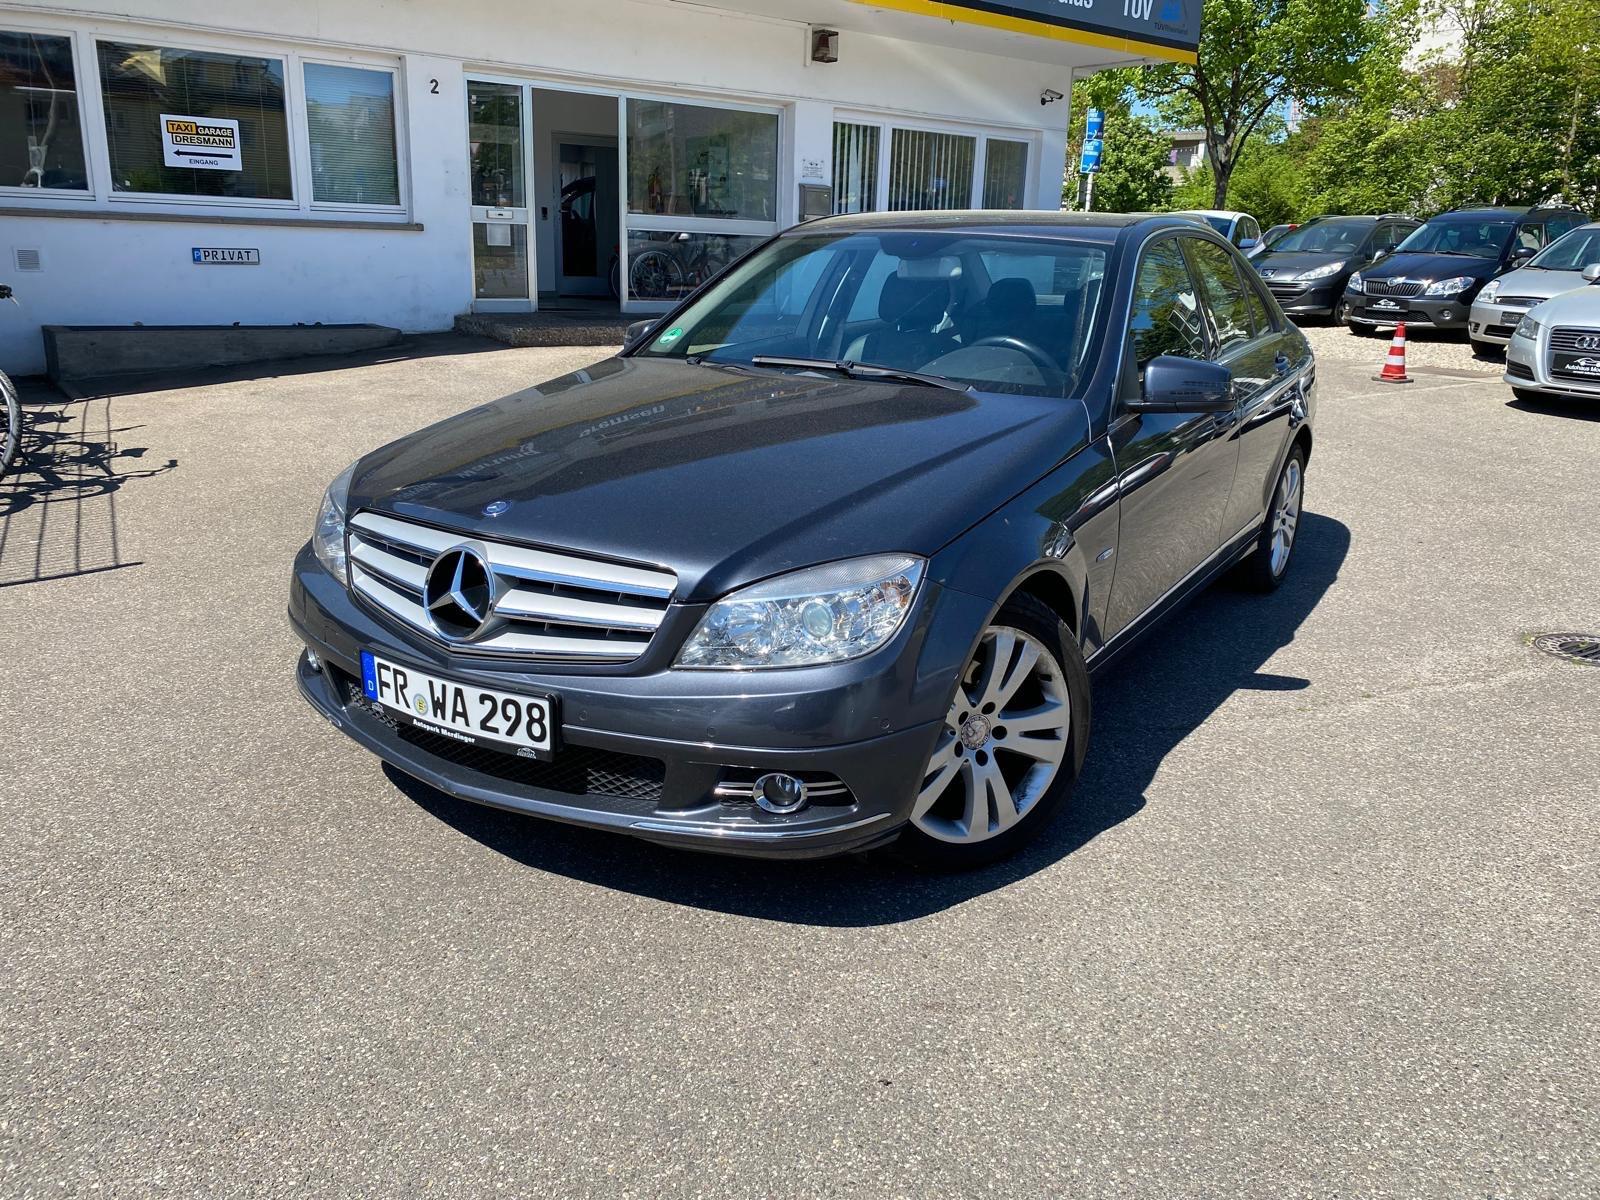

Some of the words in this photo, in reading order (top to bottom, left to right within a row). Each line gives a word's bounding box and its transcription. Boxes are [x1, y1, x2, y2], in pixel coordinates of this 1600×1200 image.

[430, 79, 439, 94] 2
[169, 122, 194, 133] TAXI
[197, 127, 233, 137] GARAGE
[174, 135, 232, 147] DRESMANN
[194, 250, 201, 260] P
[202, 250, 252, 261] PRIVAT
[367, 680, 374, 691] D
[376, 661, 411, 709] FR
[428, 679, 470, 727] WA
[479, 693, 547, 743] 298
[413, 718, 440, 733] Autopark
